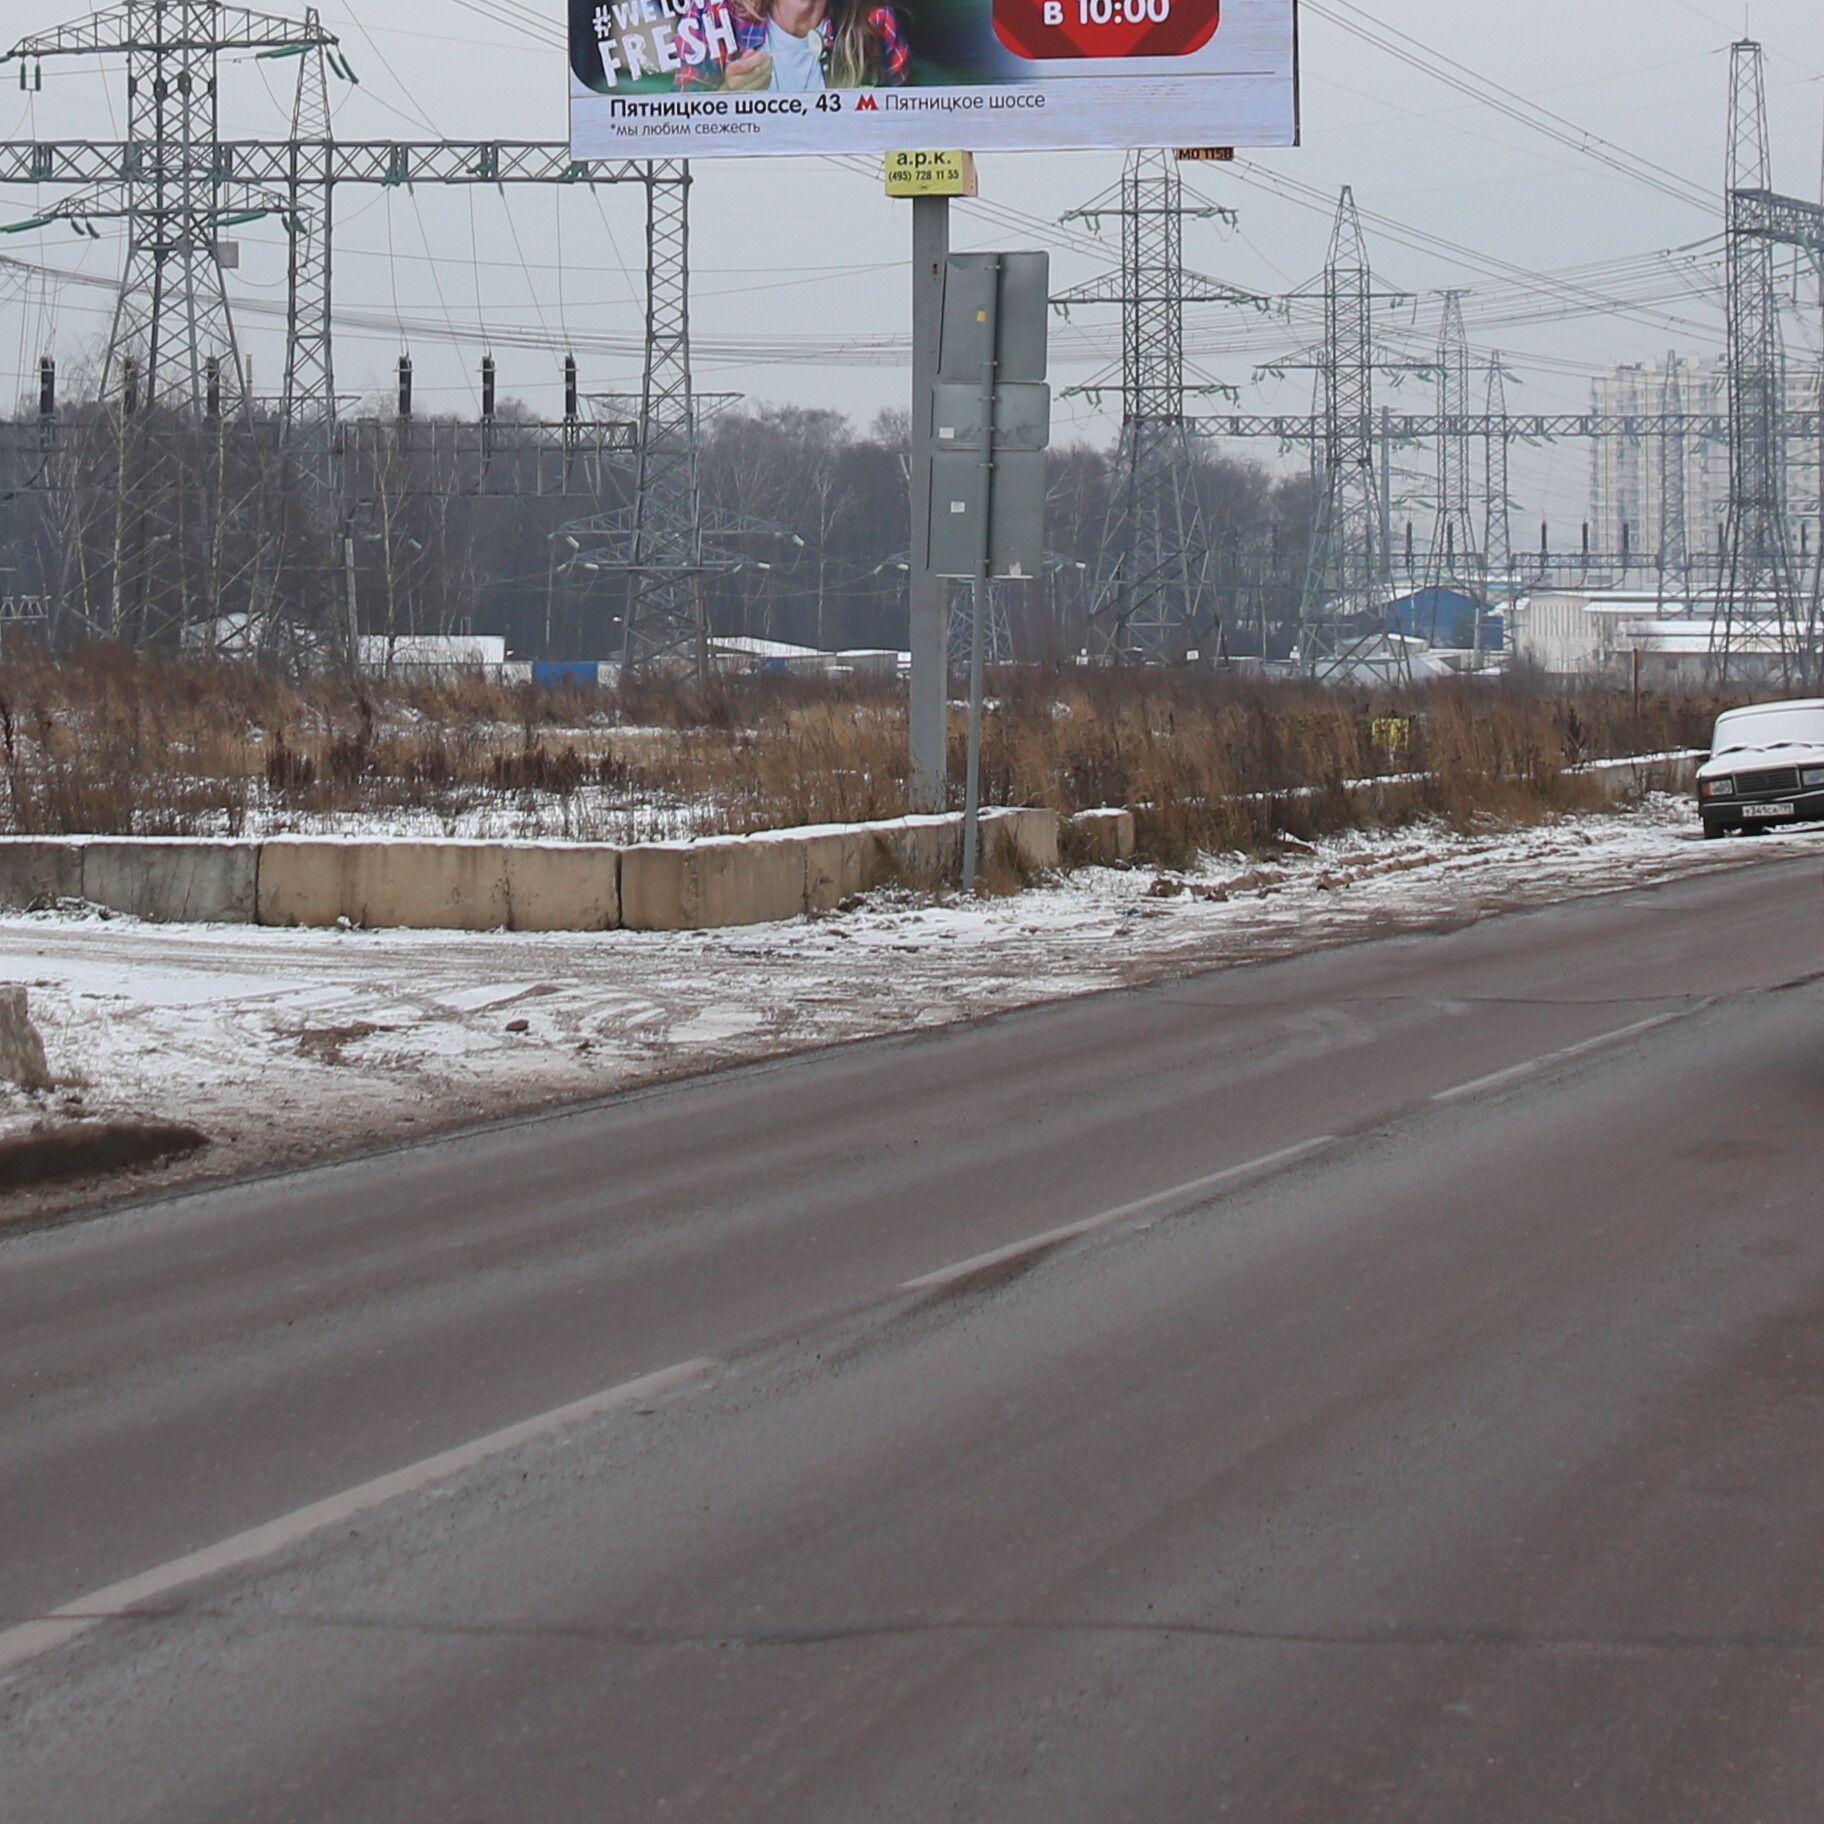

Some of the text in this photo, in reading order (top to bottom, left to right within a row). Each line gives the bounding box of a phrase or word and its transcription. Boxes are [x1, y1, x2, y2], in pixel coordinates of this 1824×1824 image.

[1043, 0, 1064, 25] в
[597, 7, 738, 88] FRESH
[610, 93, 842, 119] Пятницкое шоссе, 43
[885, 94, 984, 113] Пятницкое
[988, 92, 1046, 109] шоссе
[642, 121, 691, 136] любим
[694, 122, 761, 135] свежесть
[896, 151, 952, 169] а.р.к.
[888, 170, 960, 182] (495) 728 11 55
